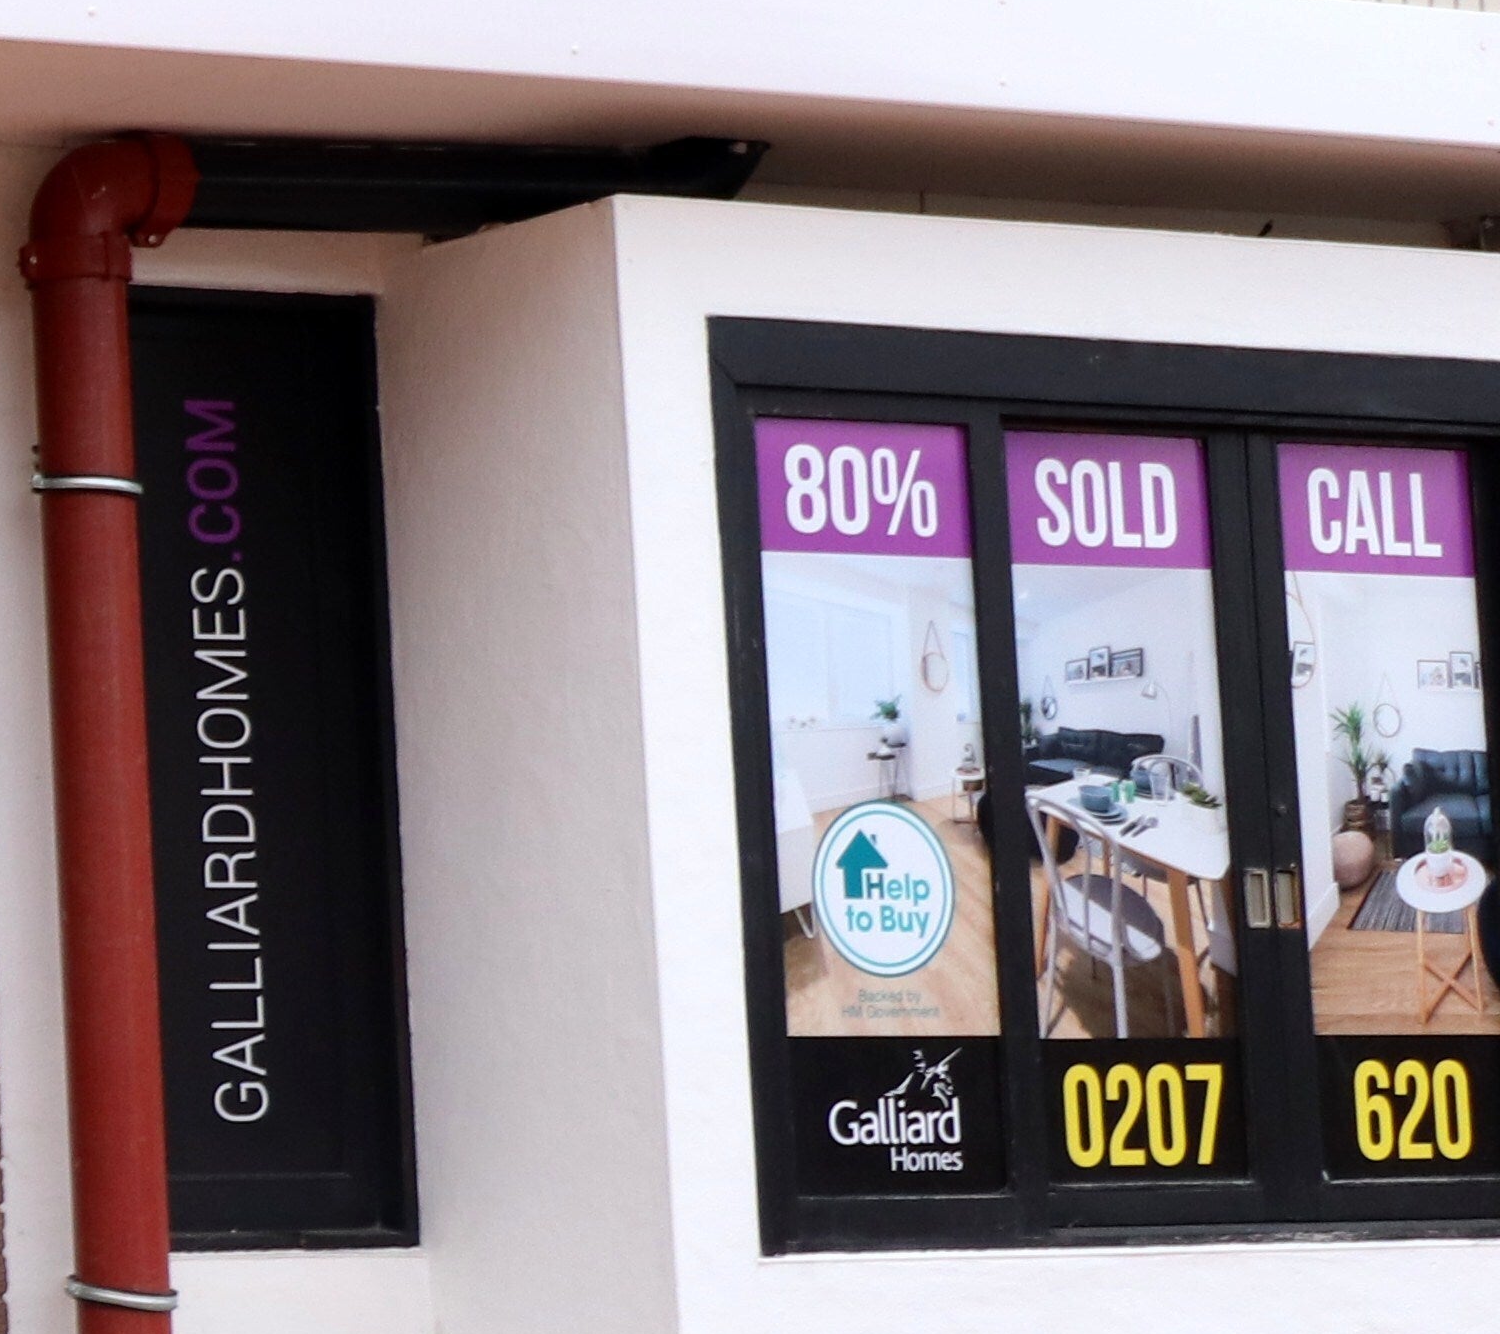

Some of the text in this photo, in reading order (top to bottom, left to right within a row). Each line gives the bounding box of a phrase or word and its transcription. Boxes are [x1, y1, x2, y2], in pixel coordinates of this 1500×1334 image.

[783, 443, 1444, 559] 80% SOLD CALL
[183, 397, 270, 1124] GALLIARDHOMES.COM
[865, 872, 931, 907] Help
[845, 904, 931, 939] to Buy
[827, 1096, 962, 1146] Galliard
[1061, 1058, 1474, 1169] 0207 620
[889, 1146, 964, 1172] Homes
